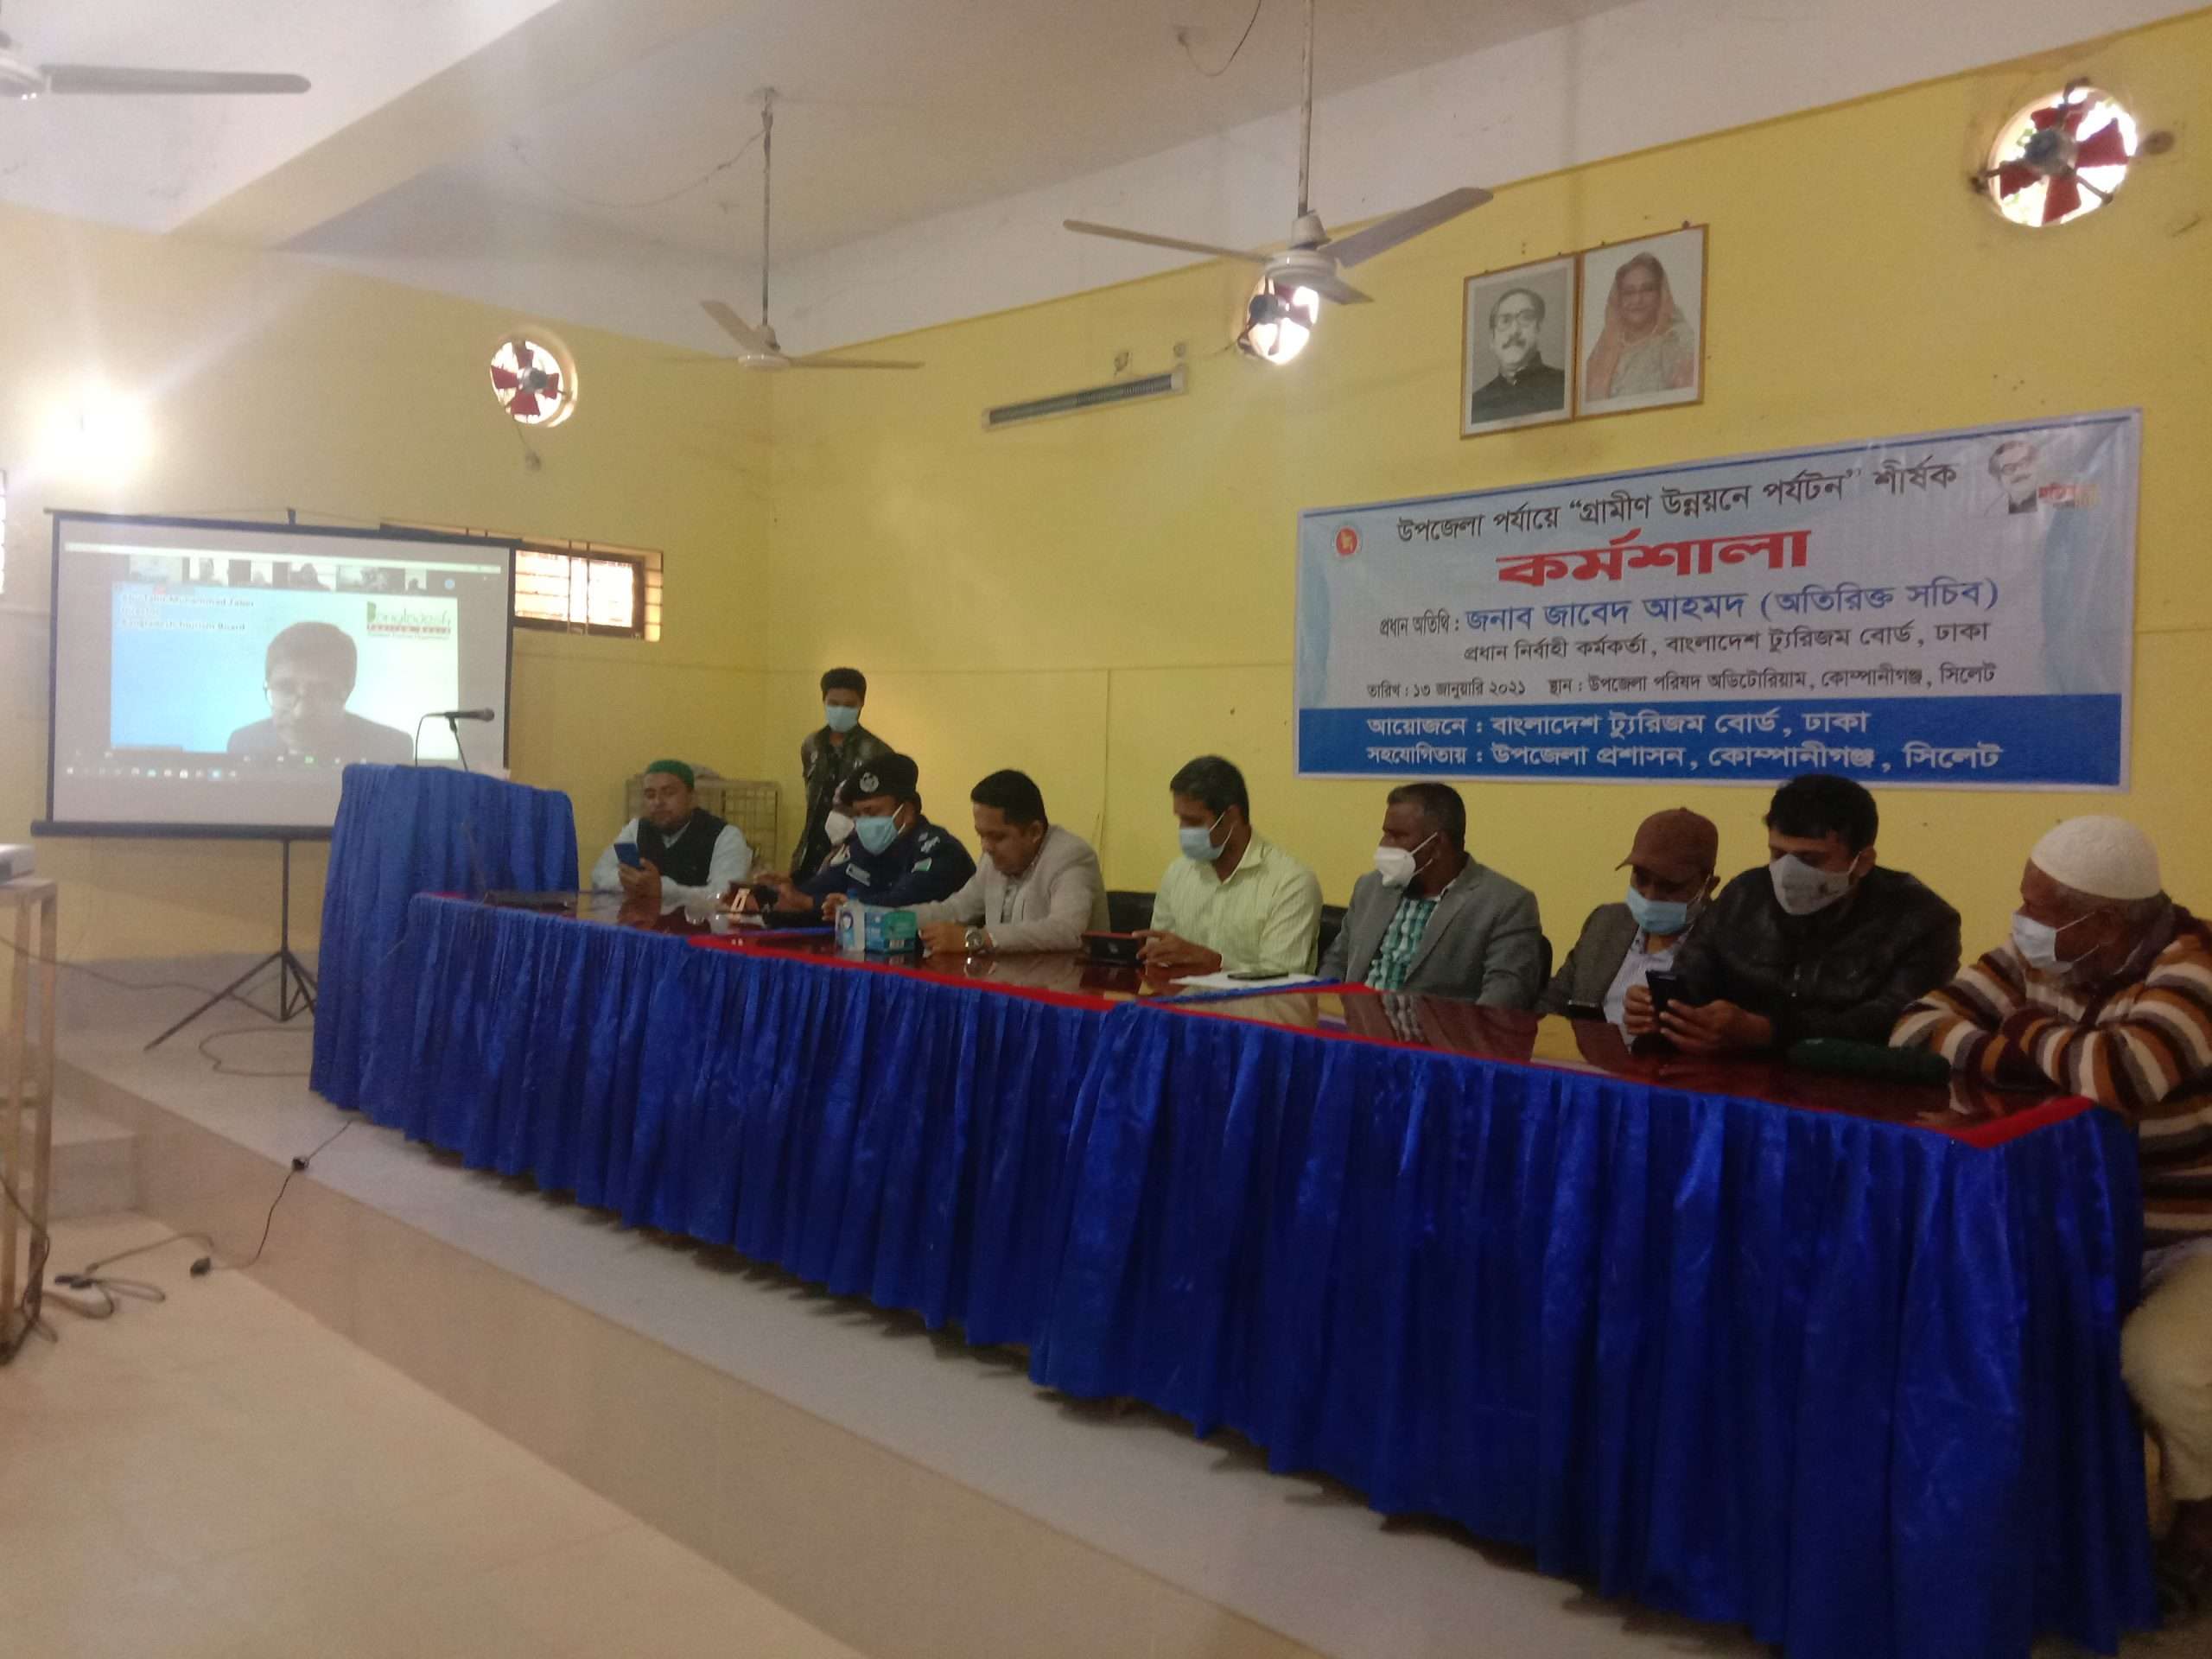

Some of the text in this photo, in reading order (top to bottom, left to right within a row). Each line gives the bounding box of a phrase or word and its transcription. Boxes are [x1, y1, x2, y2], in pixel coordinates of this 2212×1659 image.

[1396, 514, 1484, 542] উপজেলা
[1493, 502, 1560, 533] পর্যায়ে
[1661, 485, 1752, 518] উন্নয়নে
[1874, 455, 1961, 495] শীর্ষক
[1496, 527, 1812, 587] কর্মশালা
[1379, 614, 1408, 638] প্রধান
[1412, 608, 1451, 637] অতিথি
[1465, 607, 1535, 632] জনাব
[1543, 600, 1631, 629] জাবেদ
[1642, 592, 1749, 623] আহমদ
[1907, 575, 1999, 610] সচিব)
[1464, 645, 1508, 663] প্রধান
[1666, 632, 1761, 654] বাংলাদেশ
[1935, 622, 1992, 642] ঢাকা
[1489, 680, 1526, 698] ২০২১
[1587, 672, 1648, 694] উপজেলা
[1938, 660, 1997, 685] সিলেট
[1366, 716, 1468, 737] আয়োজনে
[1491, 713, 1603, 736] বাংলাদেশ
[1801, 710, 1872, 734] ঢাকা
[1491, 741, 1589, 767] উপজেলা
[1903, 741, 2004, 768] সিলেট
